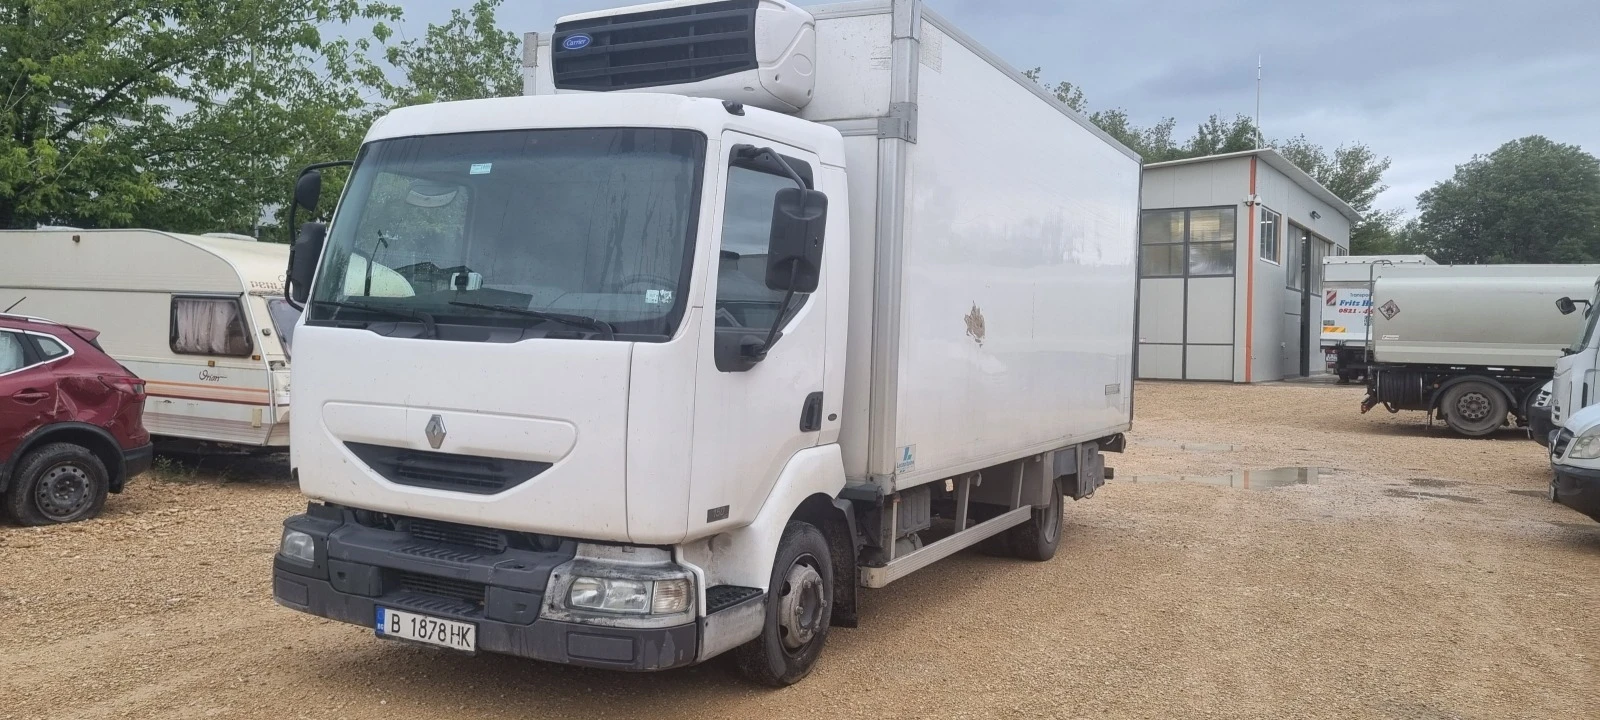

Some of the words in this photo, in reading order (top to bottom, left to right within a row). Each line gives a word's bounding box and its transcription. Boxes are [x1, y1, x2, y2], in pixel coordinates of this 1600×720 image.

[391, 613, 401, 633] B
[411, 617, 446, 642] 1878
[450, 624, 471, 648] HK
